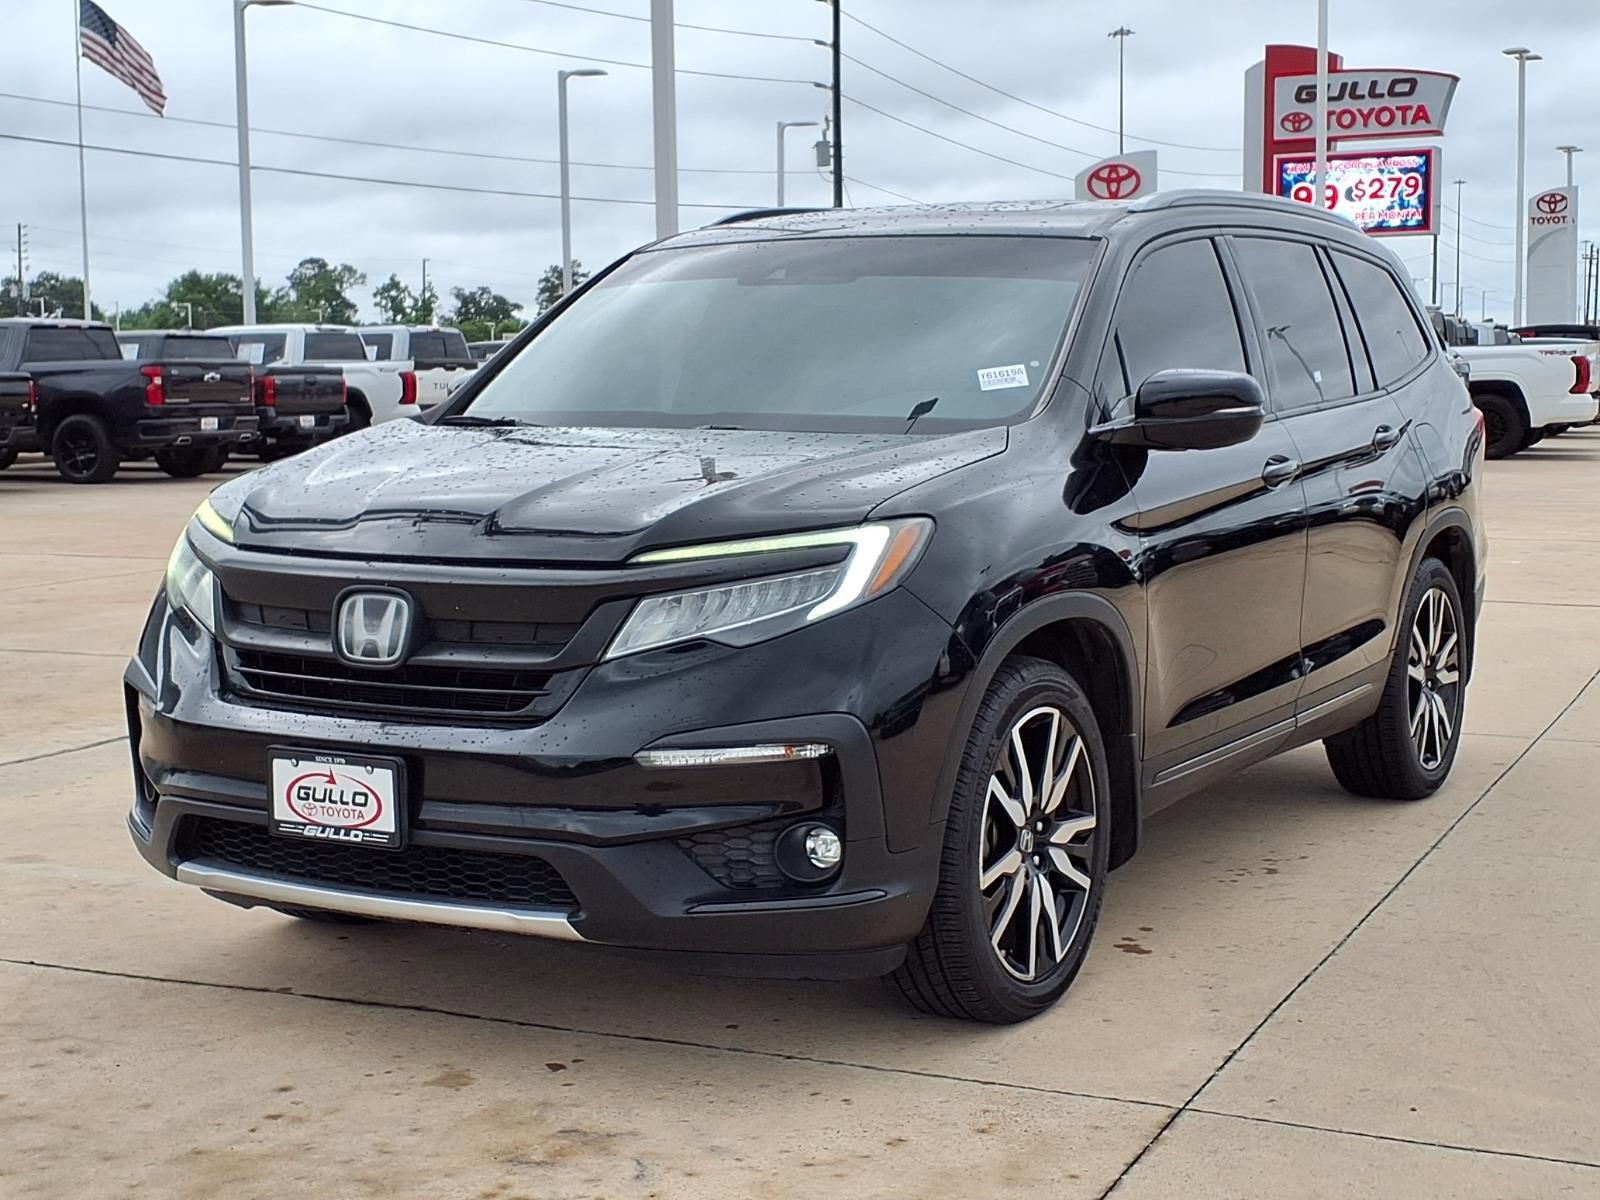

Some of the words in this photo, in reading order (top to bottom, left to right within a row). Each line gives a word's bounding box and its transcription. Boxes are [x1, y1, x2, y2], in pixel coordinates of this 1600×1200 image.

[1294, 77, 1418, 104] GULLO
[1326, 104, 1431, 130] TOYOTA
[1354, 175, 1420, 200] $279
[297, 786, 369, 807] GULLO
[319, 806, 365, 820] TOYOTA
[303, 825, 363, 842] GULLO
